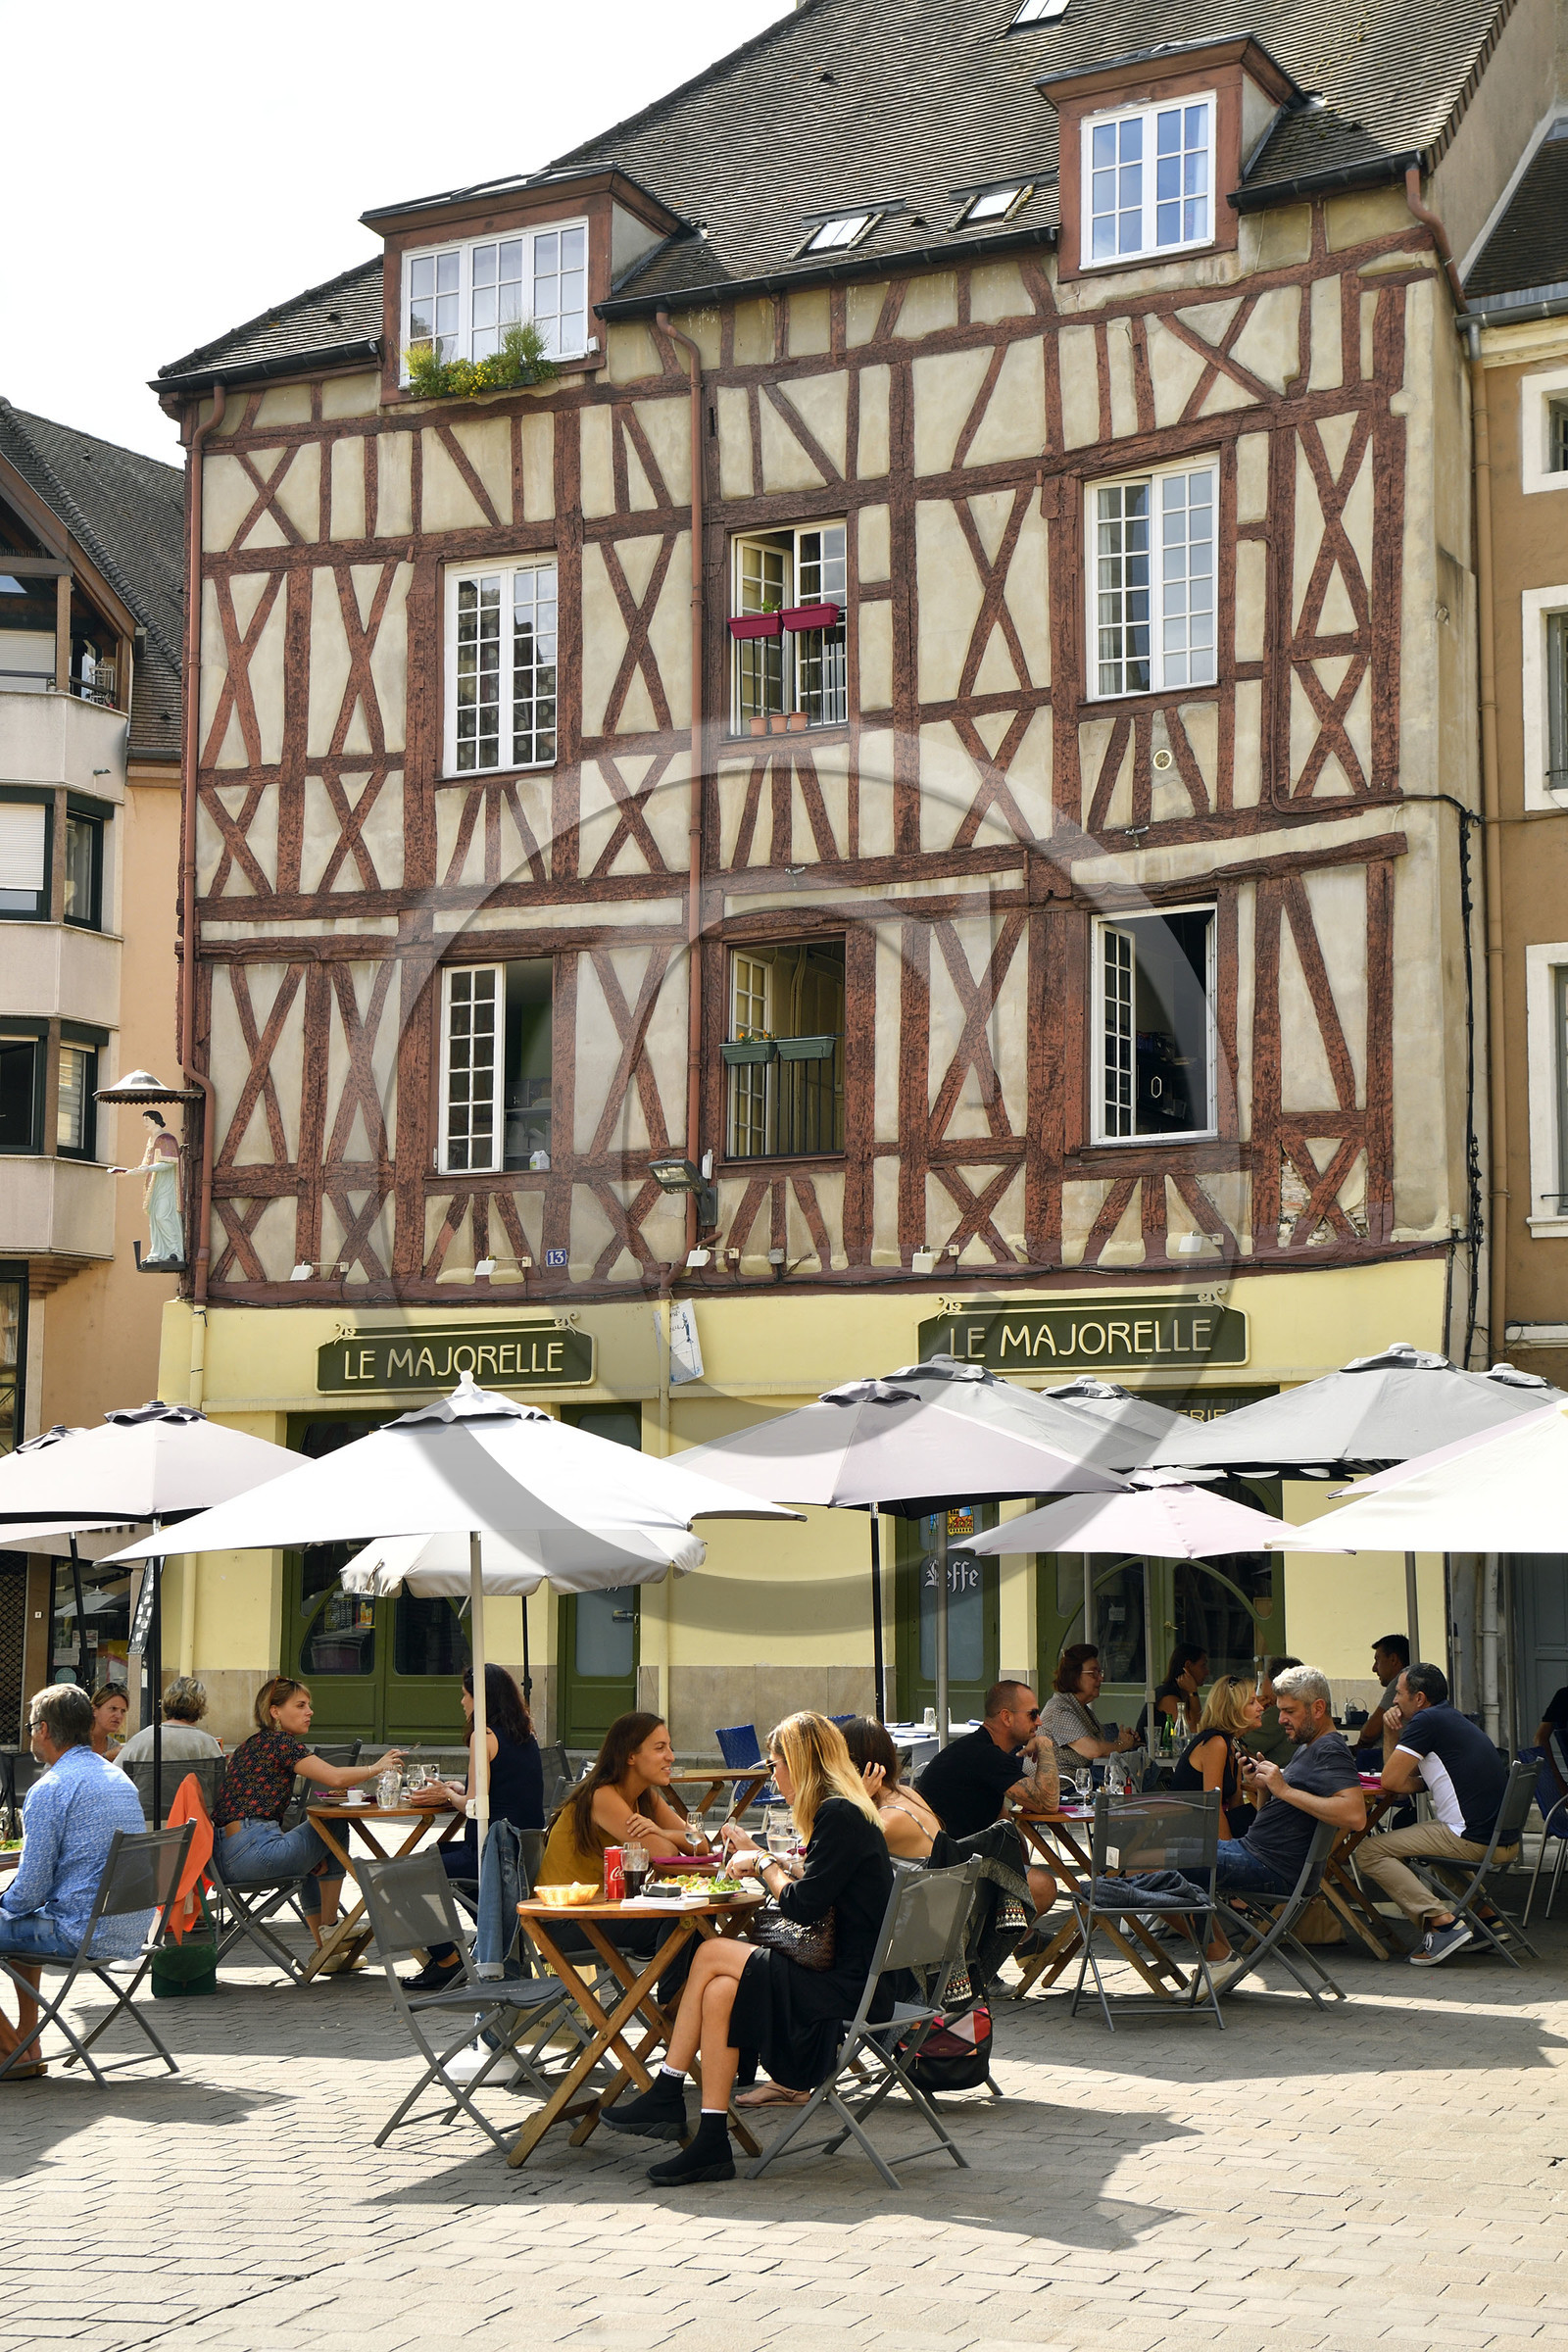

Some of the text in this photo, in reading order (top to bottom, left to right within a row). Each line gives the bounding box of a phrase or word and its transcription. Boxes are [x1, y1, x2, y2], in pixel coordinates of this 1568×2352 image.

[549, 1250, 564, 1264] 13
[951, 1319, 1211, 1359] LE MAJORELLE
[344, 1342, 564, 1380] LE MAJORELLE
